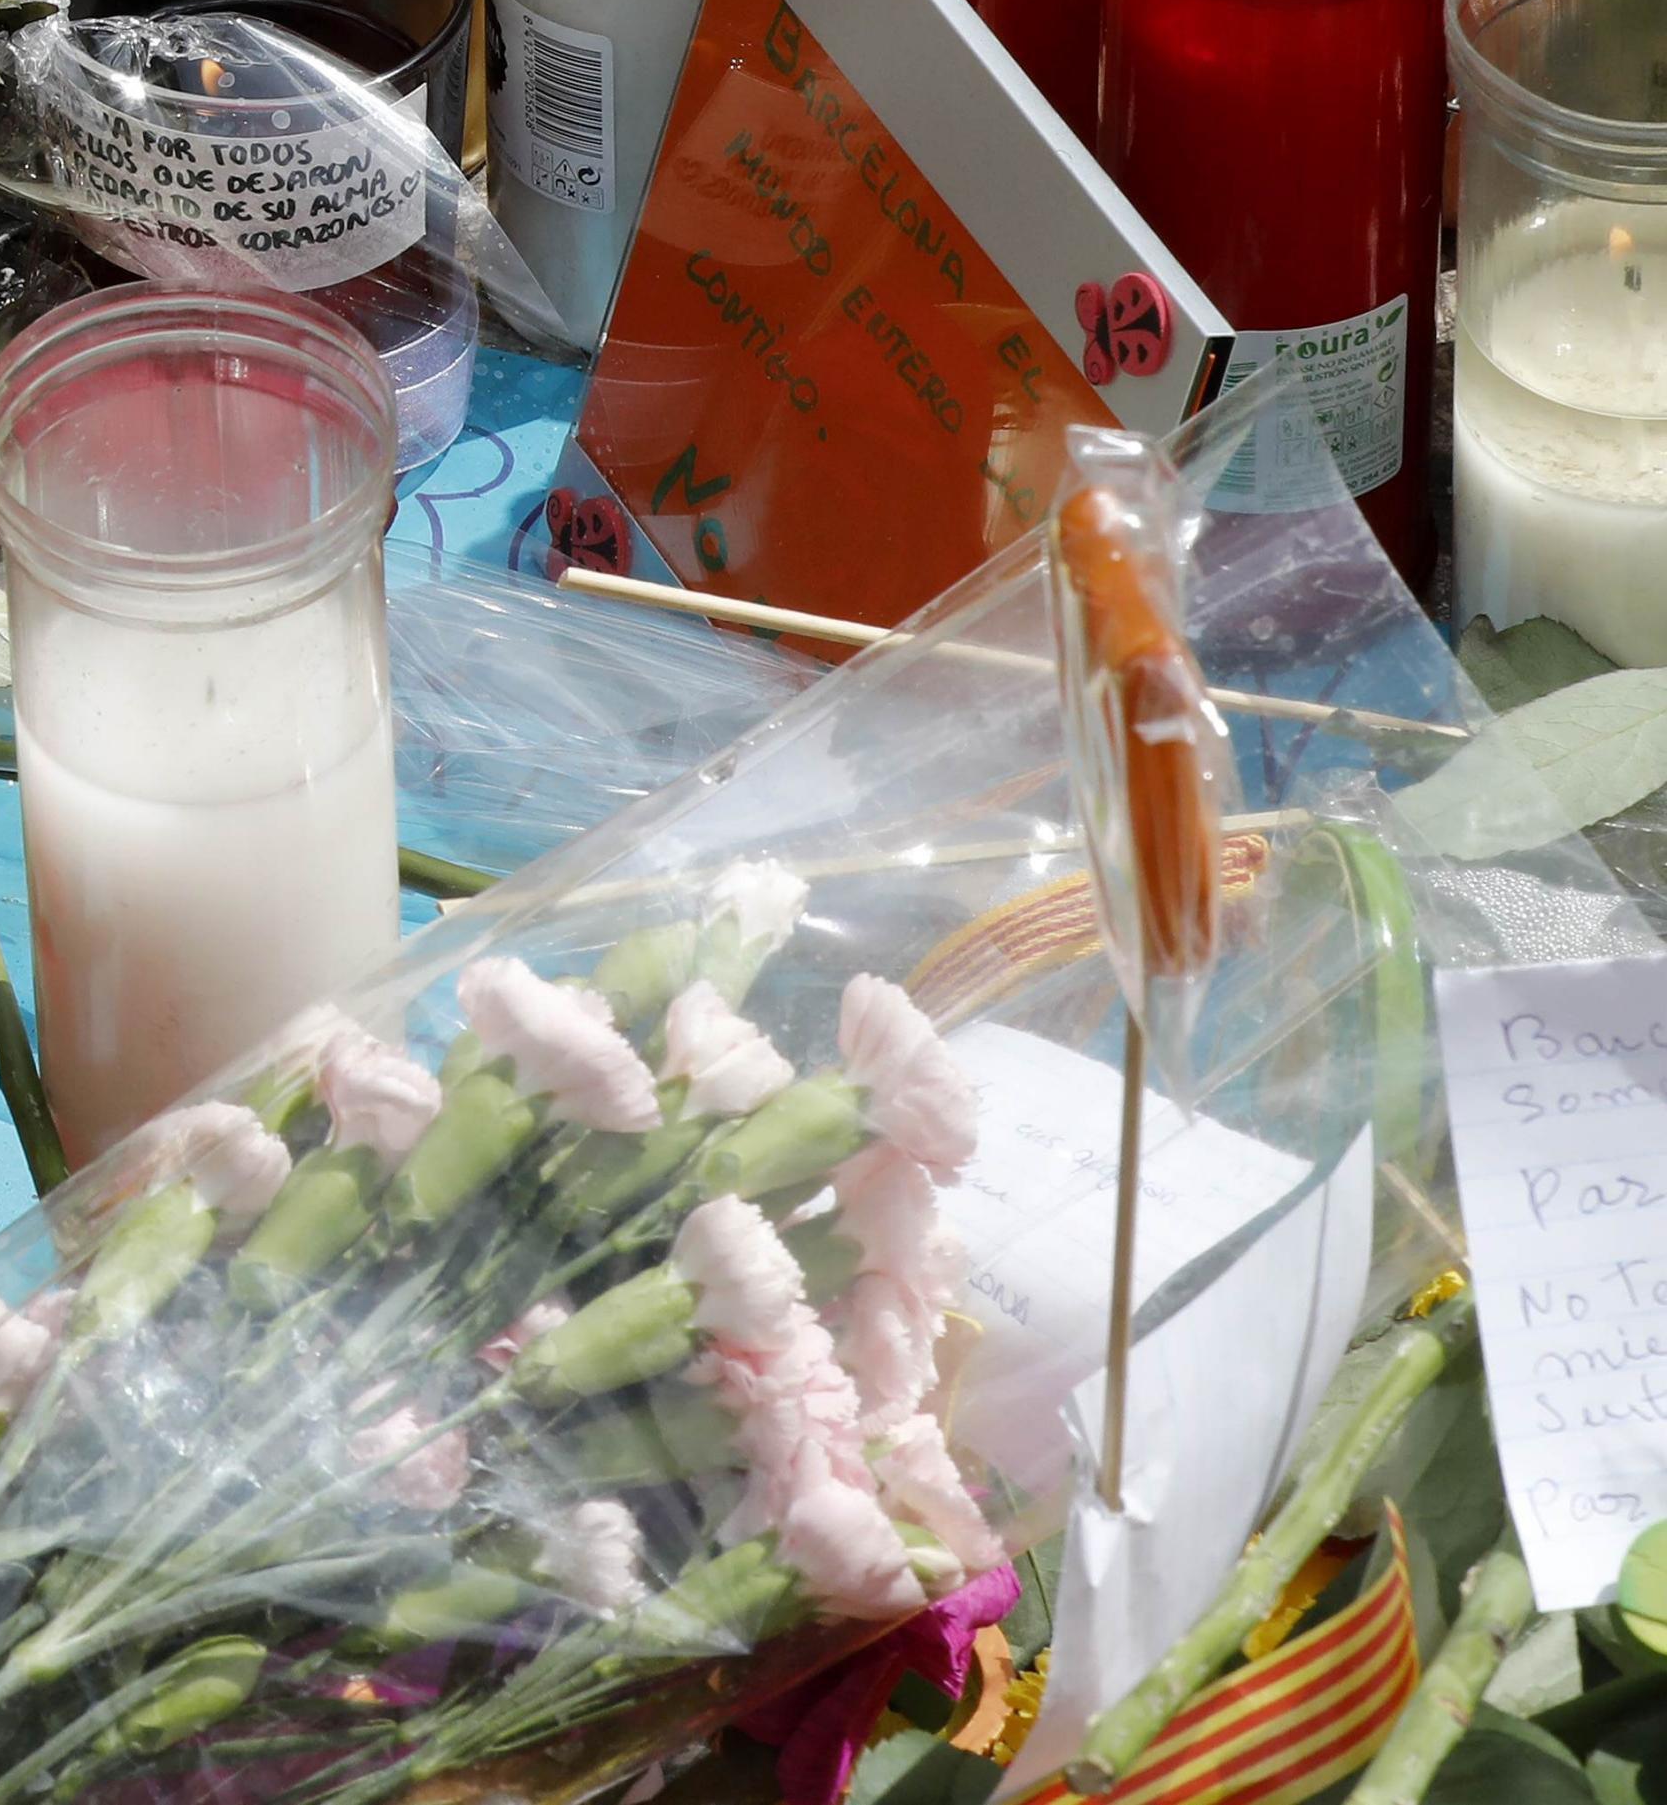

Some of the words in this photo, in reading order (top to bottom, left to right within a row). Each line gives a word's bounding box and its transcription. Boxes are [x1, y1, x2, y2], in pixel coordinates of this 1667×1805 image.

[142, 129, 197, 163] POR
[211, 139, 312, 166] TODOS
[153, 164, 216, 192] QUE
[227, 147, 372, 193] DEJARON
[764, 0, 965, 299] BARCELONA
[214, 200, 253, 221] DE
[261, 198, 297, 221] SU
[310, 168, 388, 216] ALMA
[723, 128, 833, 278] MUNDO
[841, 283, 964, 434] ENTERO
[1499, 1011, 1667, 1063] Barc
[1520, 1280, 1590, 1328] No
[1533, 1326, 1667, 1380] mie
